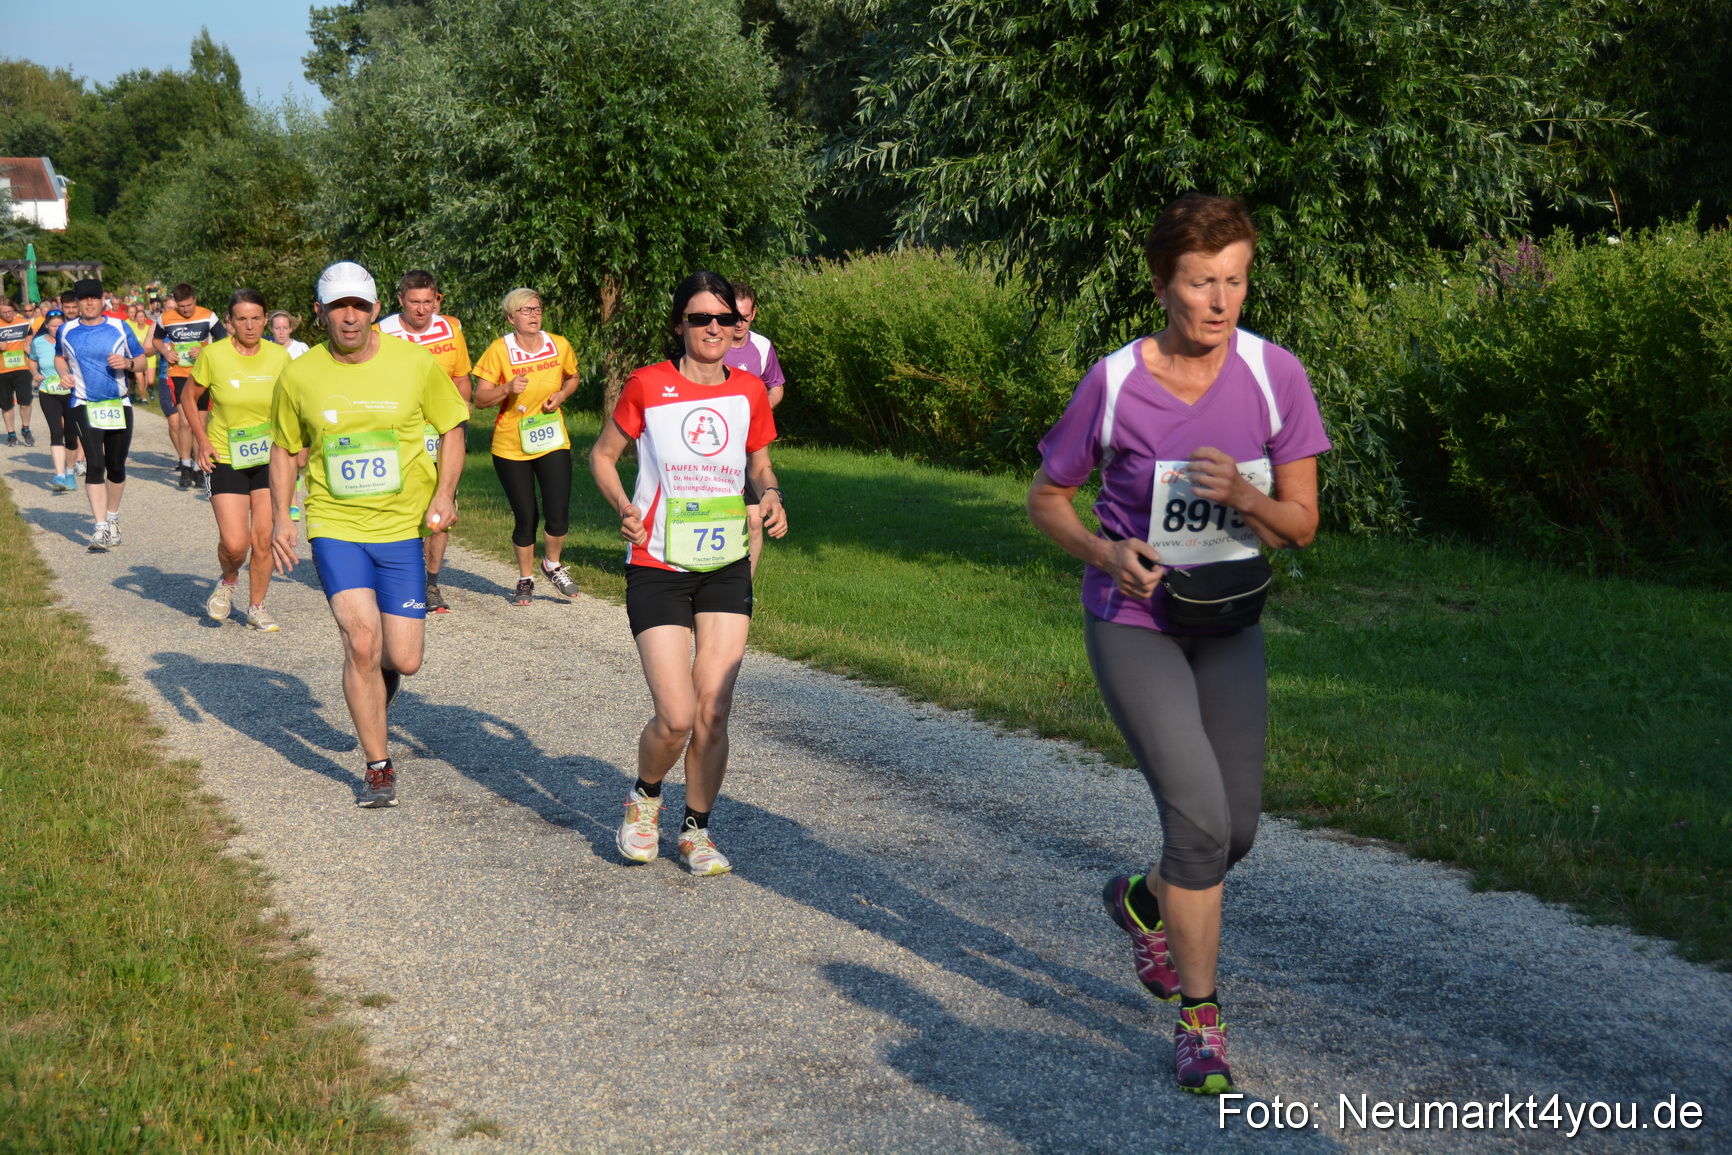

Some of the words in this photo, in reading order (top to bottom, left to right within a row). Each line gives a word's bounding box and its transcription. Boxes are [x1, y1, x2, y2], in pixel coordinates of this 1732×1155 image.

[512, 366, 534, 375] MAX
[537, 360, 561, 372] BÖGL
[92, 409, 121, 420] 1543
[529, 426, 555, 443] 899
[239, 439, 269, 457] 664
[341, 457, 387, 481] 678
[673, 484, 732, 494] Leistungsdiagnostik
[693, 527, 726, 552] 75
[1152, 531, 1255, 548] www.df-sports.de
